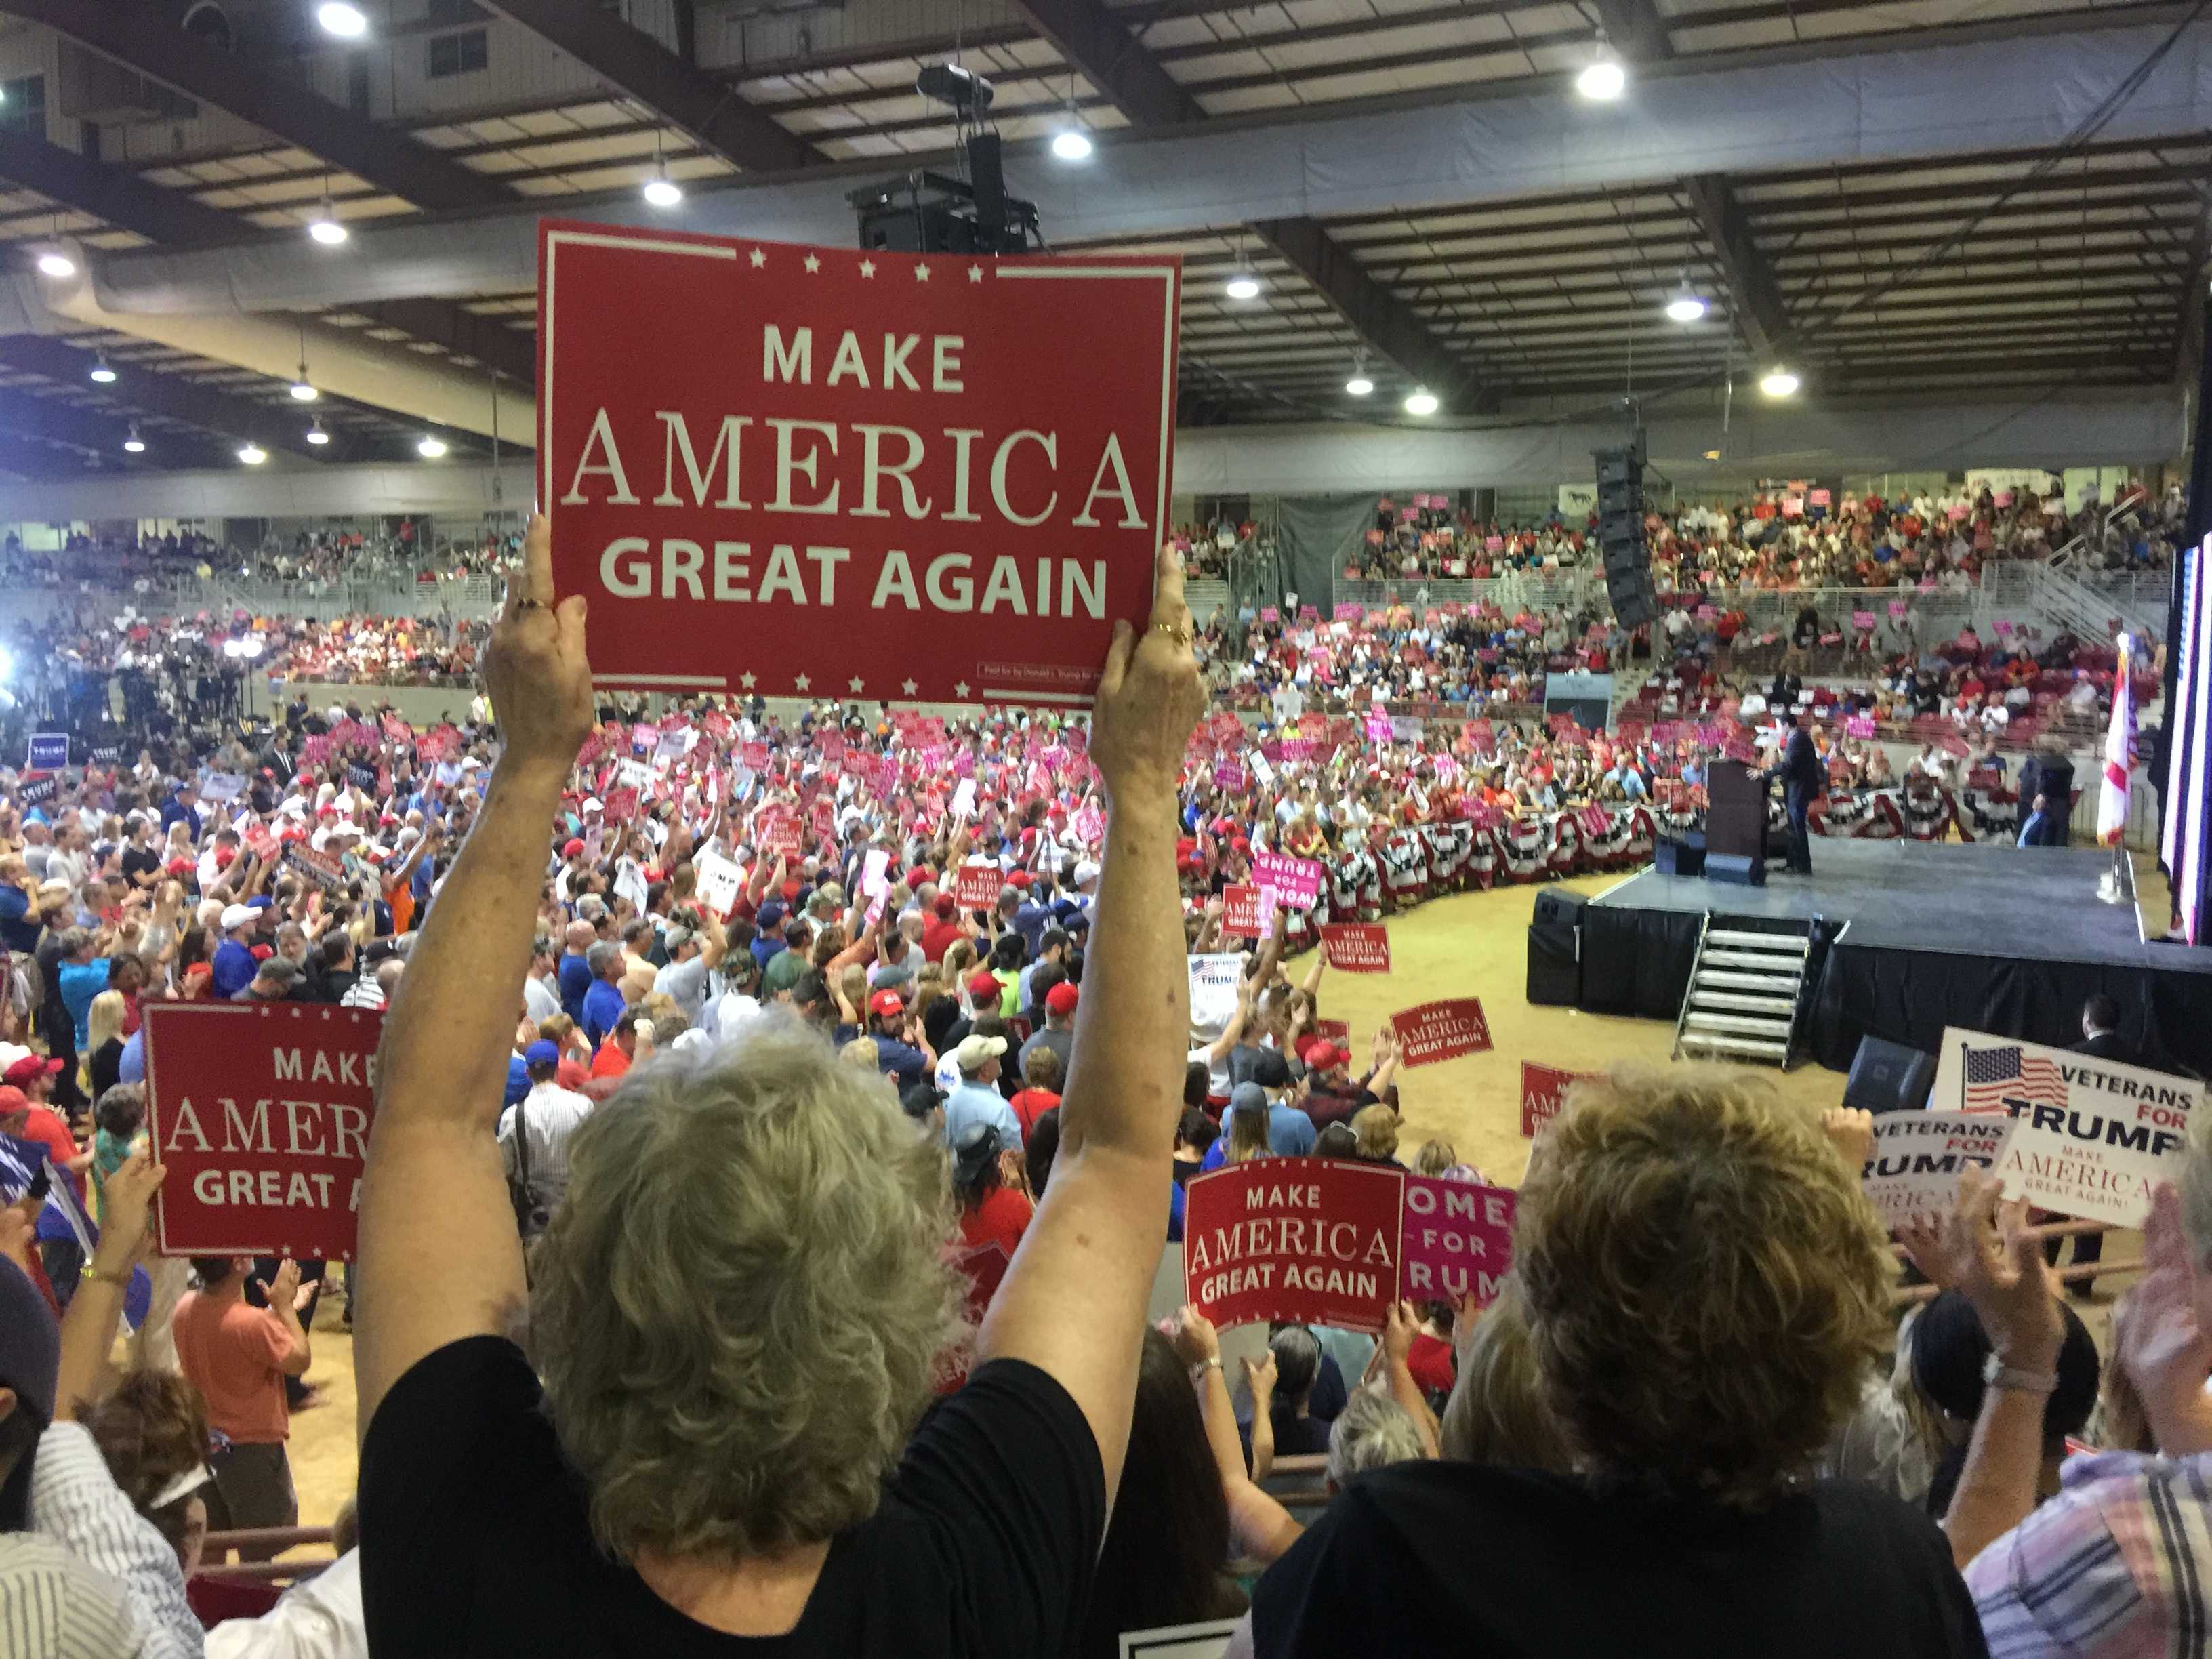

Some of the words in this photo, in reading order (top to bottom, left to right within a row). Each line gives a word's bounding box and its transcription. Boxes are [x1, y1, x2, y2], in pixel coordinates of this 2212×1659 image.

[762, 323, 965, 393] MAKE
[560, 407, 1149, 531] AMERICA
[600, 537, 851, 607] GREAT
[870, 550, 1107, 621] AGAIN
[1002, 665, 1012, 675] for
[1013, 666, 1022, 677] by
[1023, 666, 1050, 676] Donald
[1057, 668, 1080, 679] Trump
[977, 871, 997, 880] MAKE
[1258, 855, 1316, 878] TRUMP
[960, 878, 999, 893] AMERI
[1273, 873, 1297, 888] FOR
[961, 890, 985, 902] GREAT
[1328, 939, 1388, 956] AMERICA
[1343, 930, 1365, 939] MAKE
[1332, 954, 1357, 965] GREAT
[1358, 955, 1385, 965] AGAIN
[1421, 1008, 1452, 1023] MAKE
[1401, 1017, 1484, 1045] AMERICA
[1408, 1040, 1443, 1057] GREAT
[1446, 1032, 1482, 1048] AGAIN
[2060, 1063, 2193, 1111] VETERANS
[164, 1096, 369, 1162] AMER
[1872, 1120, 2006, 1139] VETERANS
[2001, 1096, 2187, 1158] TRUMP
[2136, 1103, 2188, 1131] FOR
[1945, 1138, 1996, 1154] FOR
[2062, 1145, 2102, 1164] MAKE
[2006, 1149, 2151, 1200] AMERICA
[193, 1169, 335, 1209] GREAT
[1246, 1184, 1322, 1210] MAKE
[2024, 1177, 2072, 1195] GREAT
[2075, 1189, 2129, 1210] AGAIN!
[1189, 1216, 1394, 1275] AMERICA
[1422, 1229, 1488, 1258] FOR
[1201, 1263, 1277, 1305] GREAT
[1284, 1265, 1377, 1300] AGAIN
